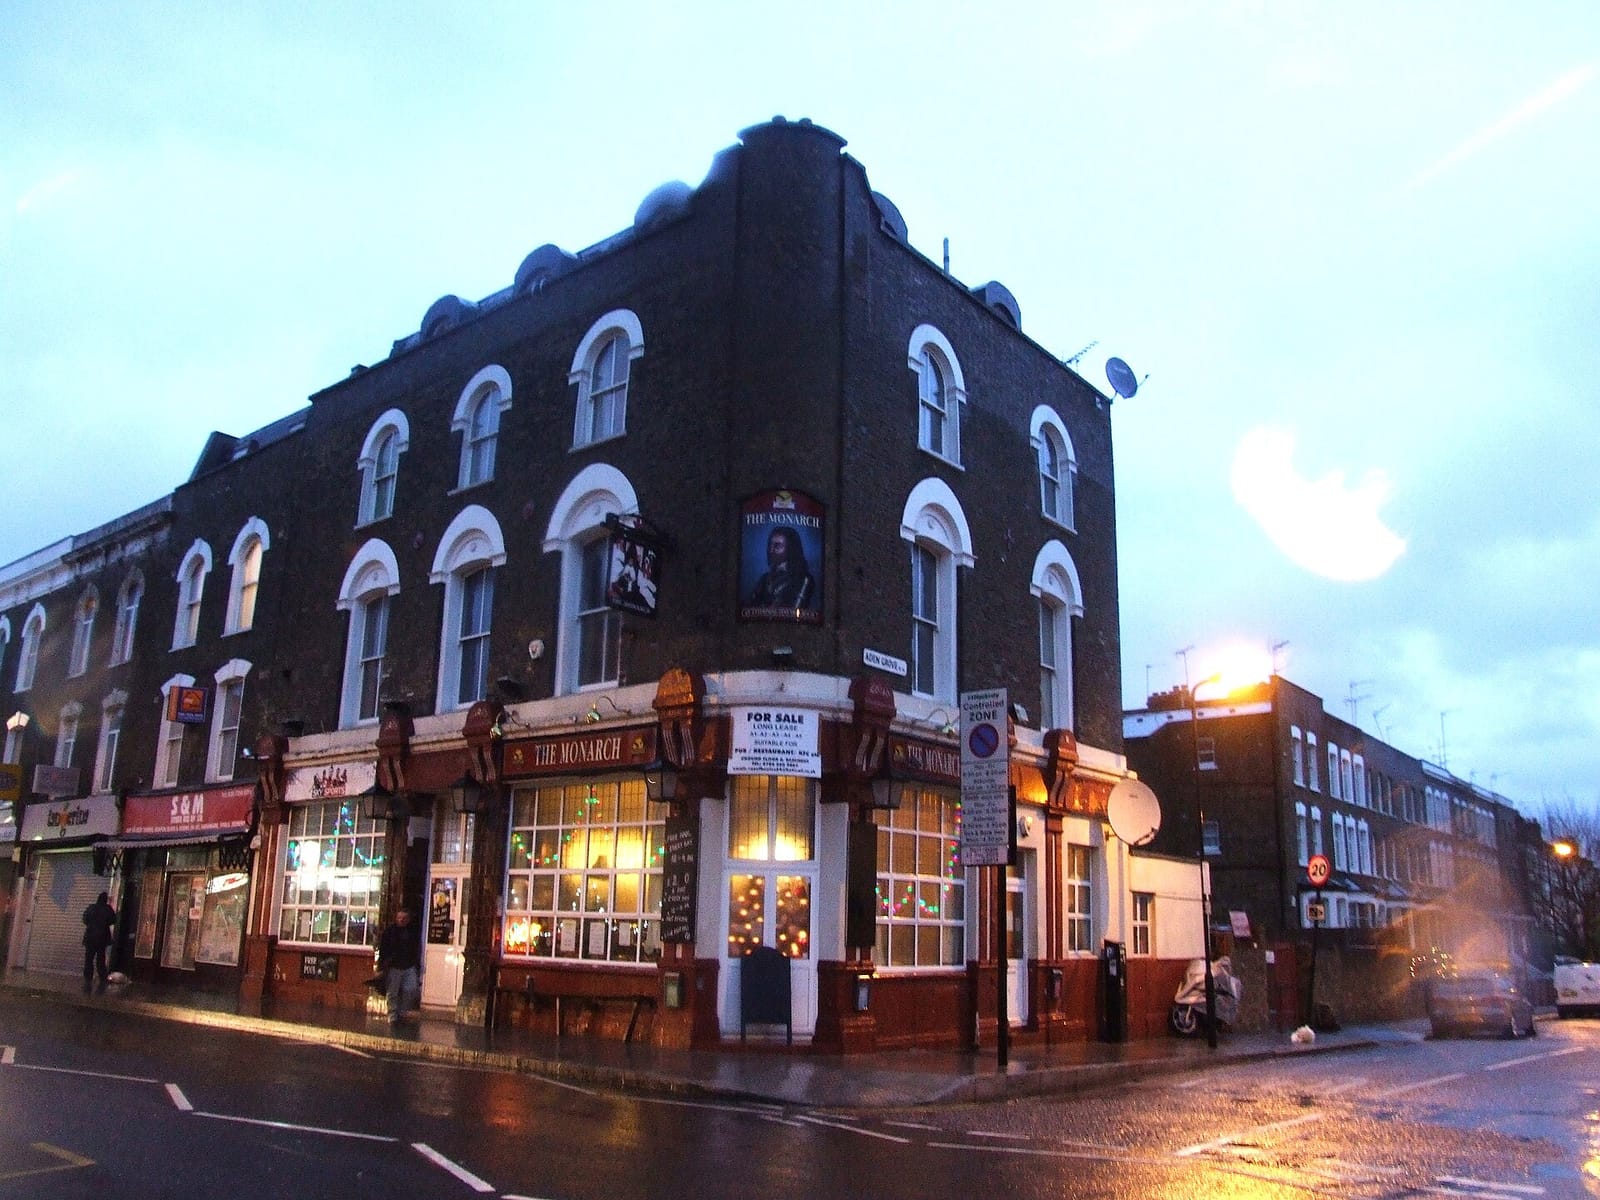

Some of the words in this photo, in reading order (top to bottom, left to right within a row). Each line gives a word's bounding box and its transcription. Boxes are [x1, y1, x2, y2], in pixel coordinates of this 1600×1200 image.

[746, 512, 766, 526] THE
[768, 512, 820, 529] MONARCH
[963, 699, 1004, 711] Controlled
[747, 712, 771, 722] FOR
[775, 713, 804, 724] SALE
[969, 710, 998, 722] ZONE
[753, 723, 773, 731] LONG
[775, 724, 798, 732] LEASE
[535, 743, 557, 766] THE
[560, 737, 621, 765] MONARCH
[171, 796, 179, 816] S
[181, 795, 190, 815] &
[192, 793, 203, 815] M
[1312, 864, 1326, 876] 20
